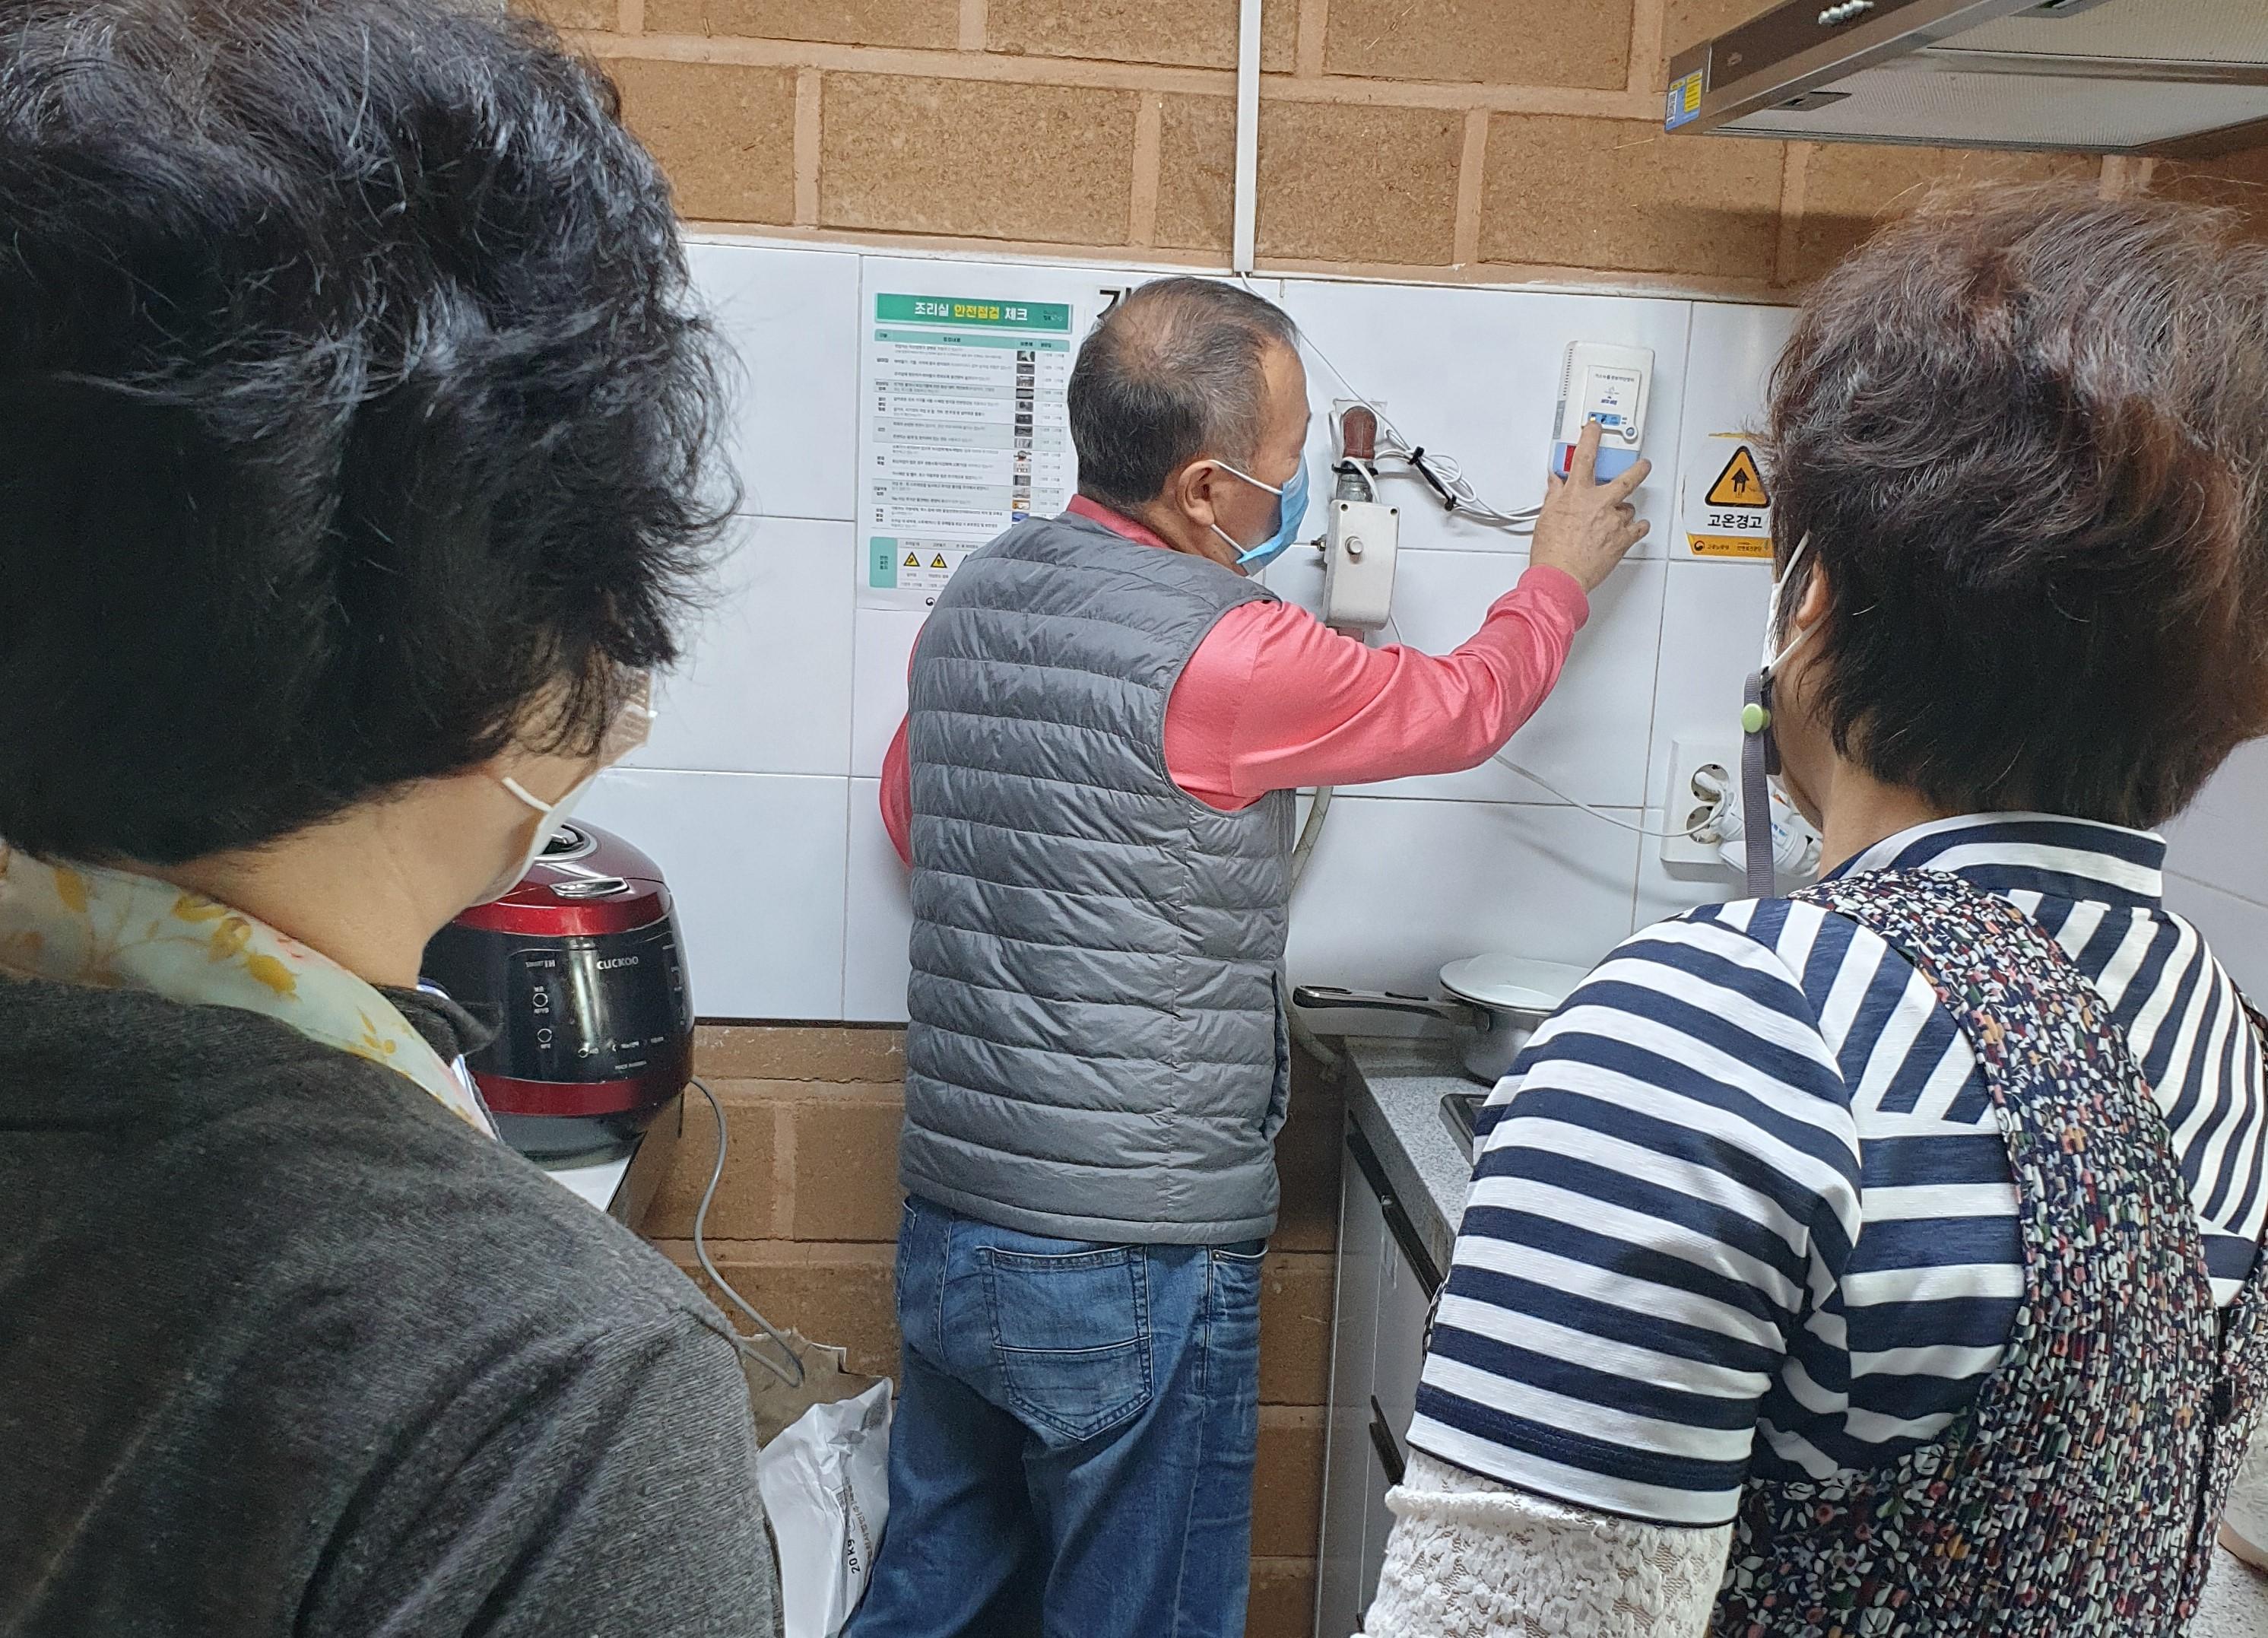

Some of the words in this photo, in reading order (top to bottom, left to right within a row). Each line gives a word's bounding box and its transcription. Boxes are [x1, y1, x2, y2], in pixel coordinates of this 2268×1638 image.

[915, 302, 950, 316] 조리실
[954, 304, 1000, 319] 안전점검
[1004, 307, 1028, 321] 체크
[1707, 514, 1762, 529] 고온경고
[596, 956, 639, 970] CUCKOO
[849, 1558, 861, 1574] 20
